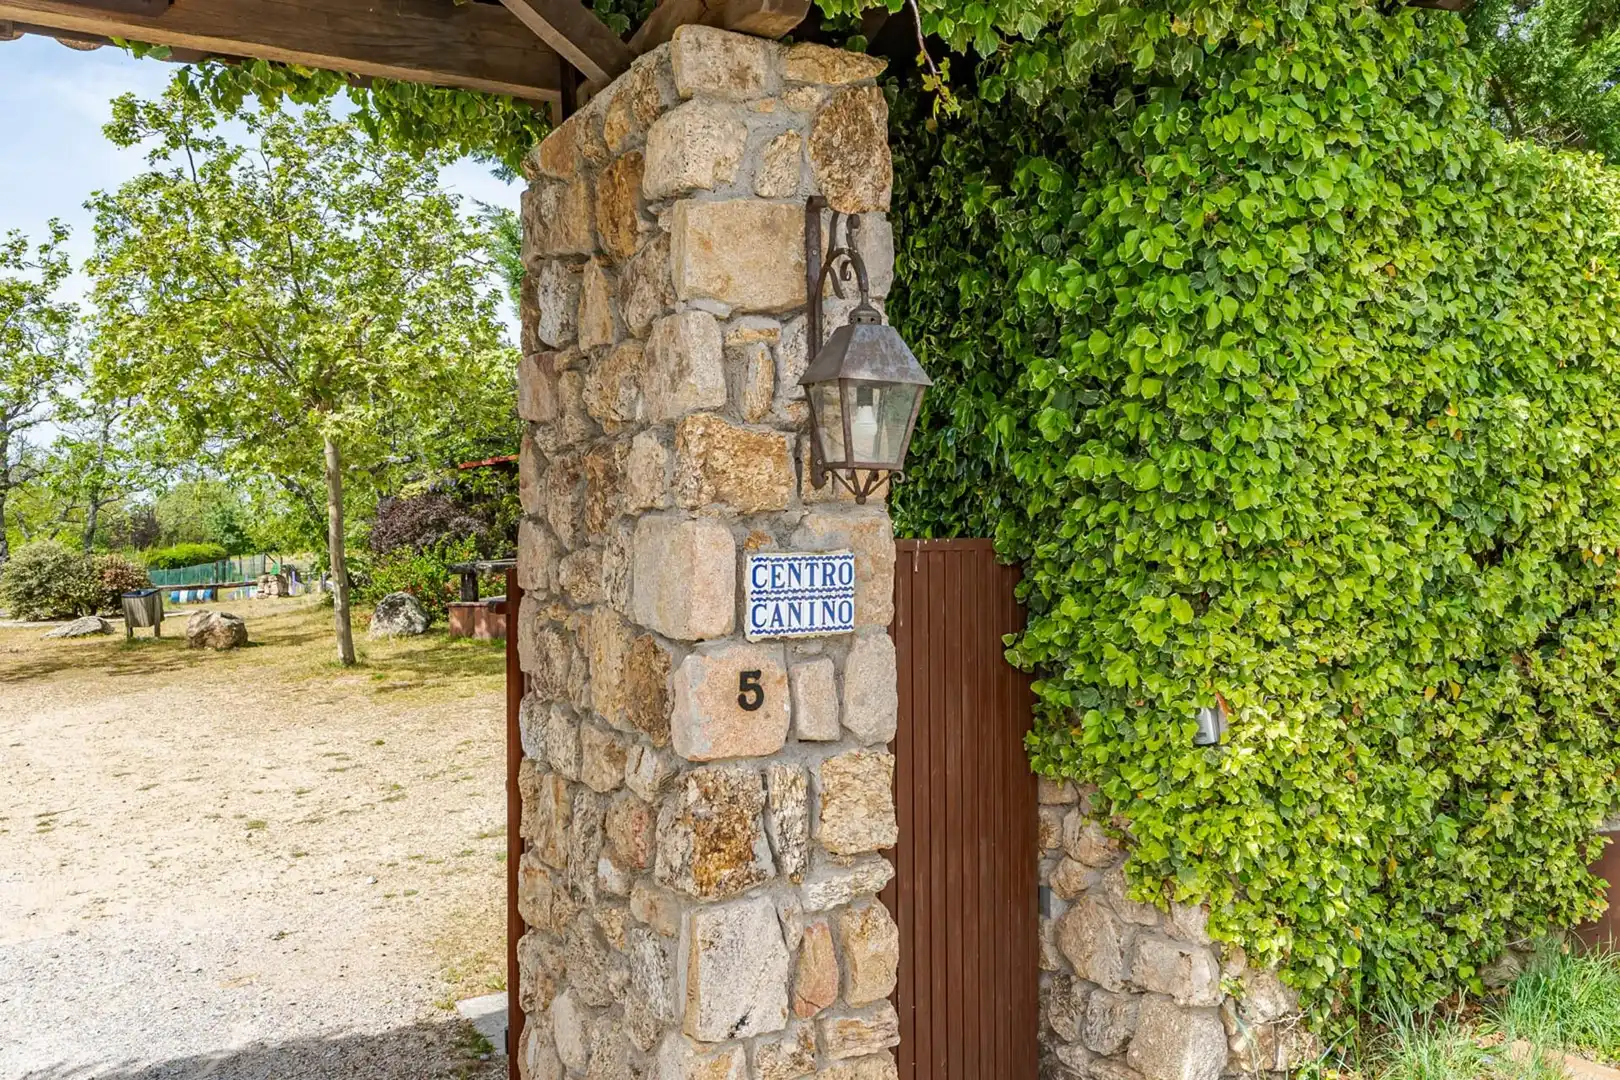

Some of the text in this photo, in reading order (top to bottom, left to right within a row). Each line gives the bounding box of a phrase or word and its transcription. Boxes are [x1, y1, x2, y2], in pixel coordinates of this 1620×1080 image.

[752, 562, 853, 589] CENTRO
[751, 600, 853, 628] CANINO
[738, 669, 765, 712] 5
